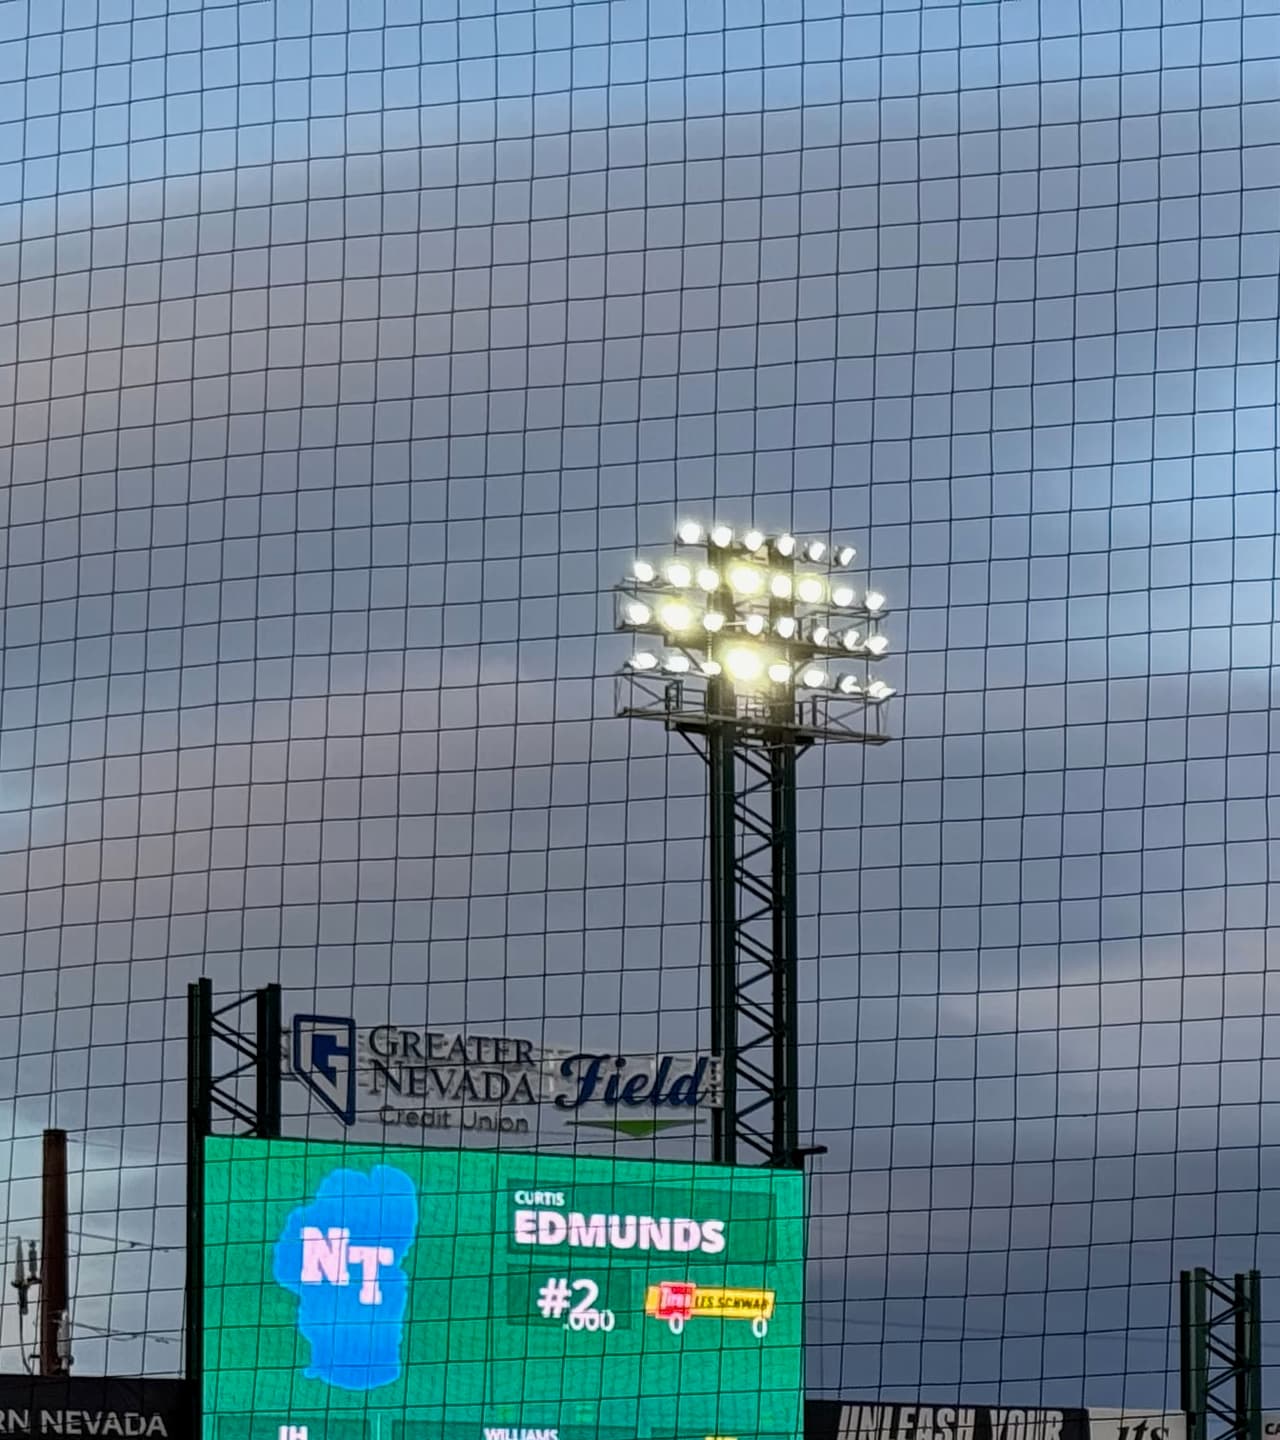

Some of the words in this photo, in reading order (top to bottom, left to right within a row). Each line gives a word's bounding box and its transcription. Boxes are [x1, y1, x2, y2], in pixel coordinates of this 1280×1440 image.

[369, 1025, 536, 1066] GREATER
[369, 1059, 538, 1104] NEVADA
[555, 1054, 710, 1109] Field
[379, 1105, 451, 1130] Credit
[461, 1109, 530, 1133] Union
[514, 1190, 565, 1207] CURTIS
[514, 1210, 726, 1254] EDMUNDS
[300, 1227, 394, 1306] NT
[537, 1277, 600, 1319] #2
[695, 1295, 715, 1308] LES
[718, 1296, 770, 1312] SCHWAB
[41, 1409, 168, 1438] NEVADA
